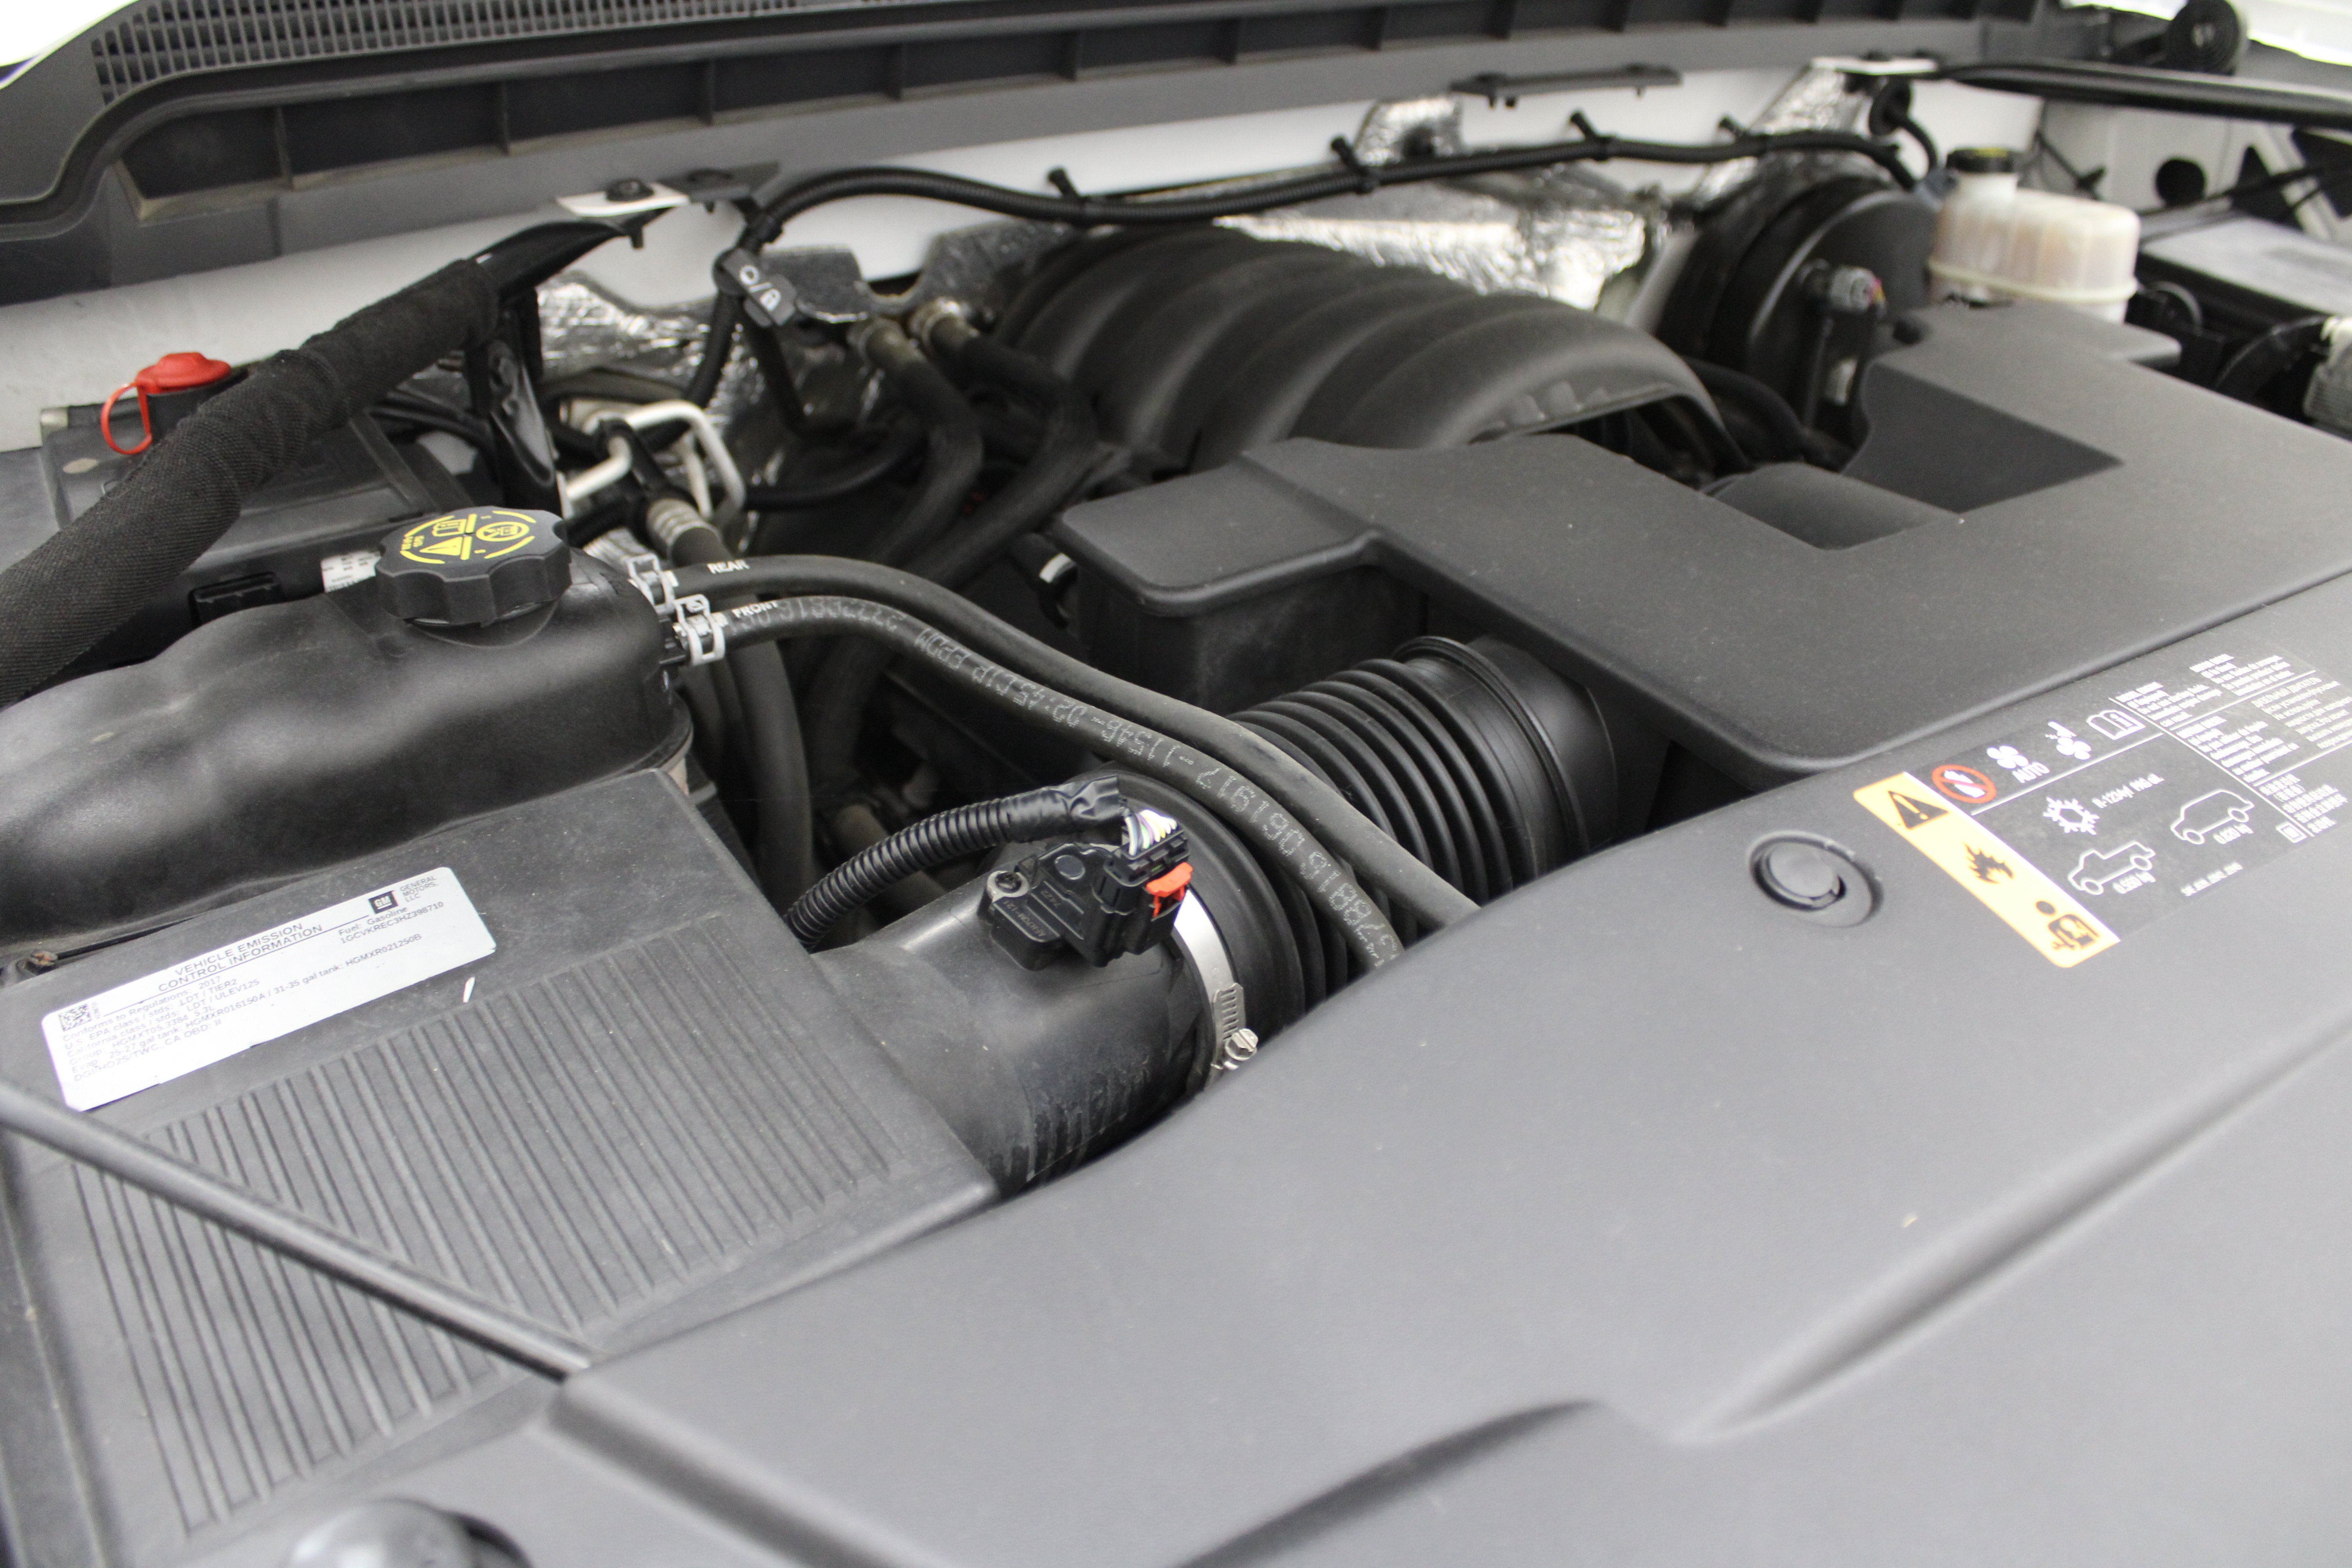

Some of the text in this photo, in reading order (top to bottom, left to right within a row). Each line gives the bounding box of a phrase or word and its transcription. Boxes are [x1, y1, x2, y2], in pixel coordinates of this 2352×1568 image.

[707, 559, 750, 574] REAR
[732, 601, 779, 618] FRONT
[914, 628, 971, 670] EPDM
[2012, 762, 2050, 783] AUTO
[400, 875, 437, 891] GENERAL
[405, 893, 421, 902] LLC
[374, 895, 391, 907] GM
[338, 907, 407, 936] Fuel: Gasoline
[340, 901, 444, 944] 1GCVKREC3HZ398710
[158, 924, 323, 991] CONTROL INFORMATION
[174, 922, 303, 975] VEHICLE EMISSION
[62, 1018, 113, 1042] Conforms
[129, 990, 188, 1015] Regulations:
[198, 976, 220, 989] 2017
[89, 1028, 110, 1040] EPA
[114, 1018, 140, 1031] class
[148, 1006, 169, 1017] stds:
[179, 992, 198, 1006] LDT
[207, 978, 237, 993] TIER2
[120, 1023, 146, 1036] class
[156, 1011, 176, 1023] stds:
[186, 999, 205, 1011] LDT
[214, 978, 260, 1000] ULEV125
[139, 1036, 154, 1048] gal
[273, 979, 300, 994] 31-35
[302, 972, 317, 984] gal
[318, 964, 343, 976] tank:
[194, 1005, 214, 1016] 5.3L
[165, 1035, 180, 1045] CA
